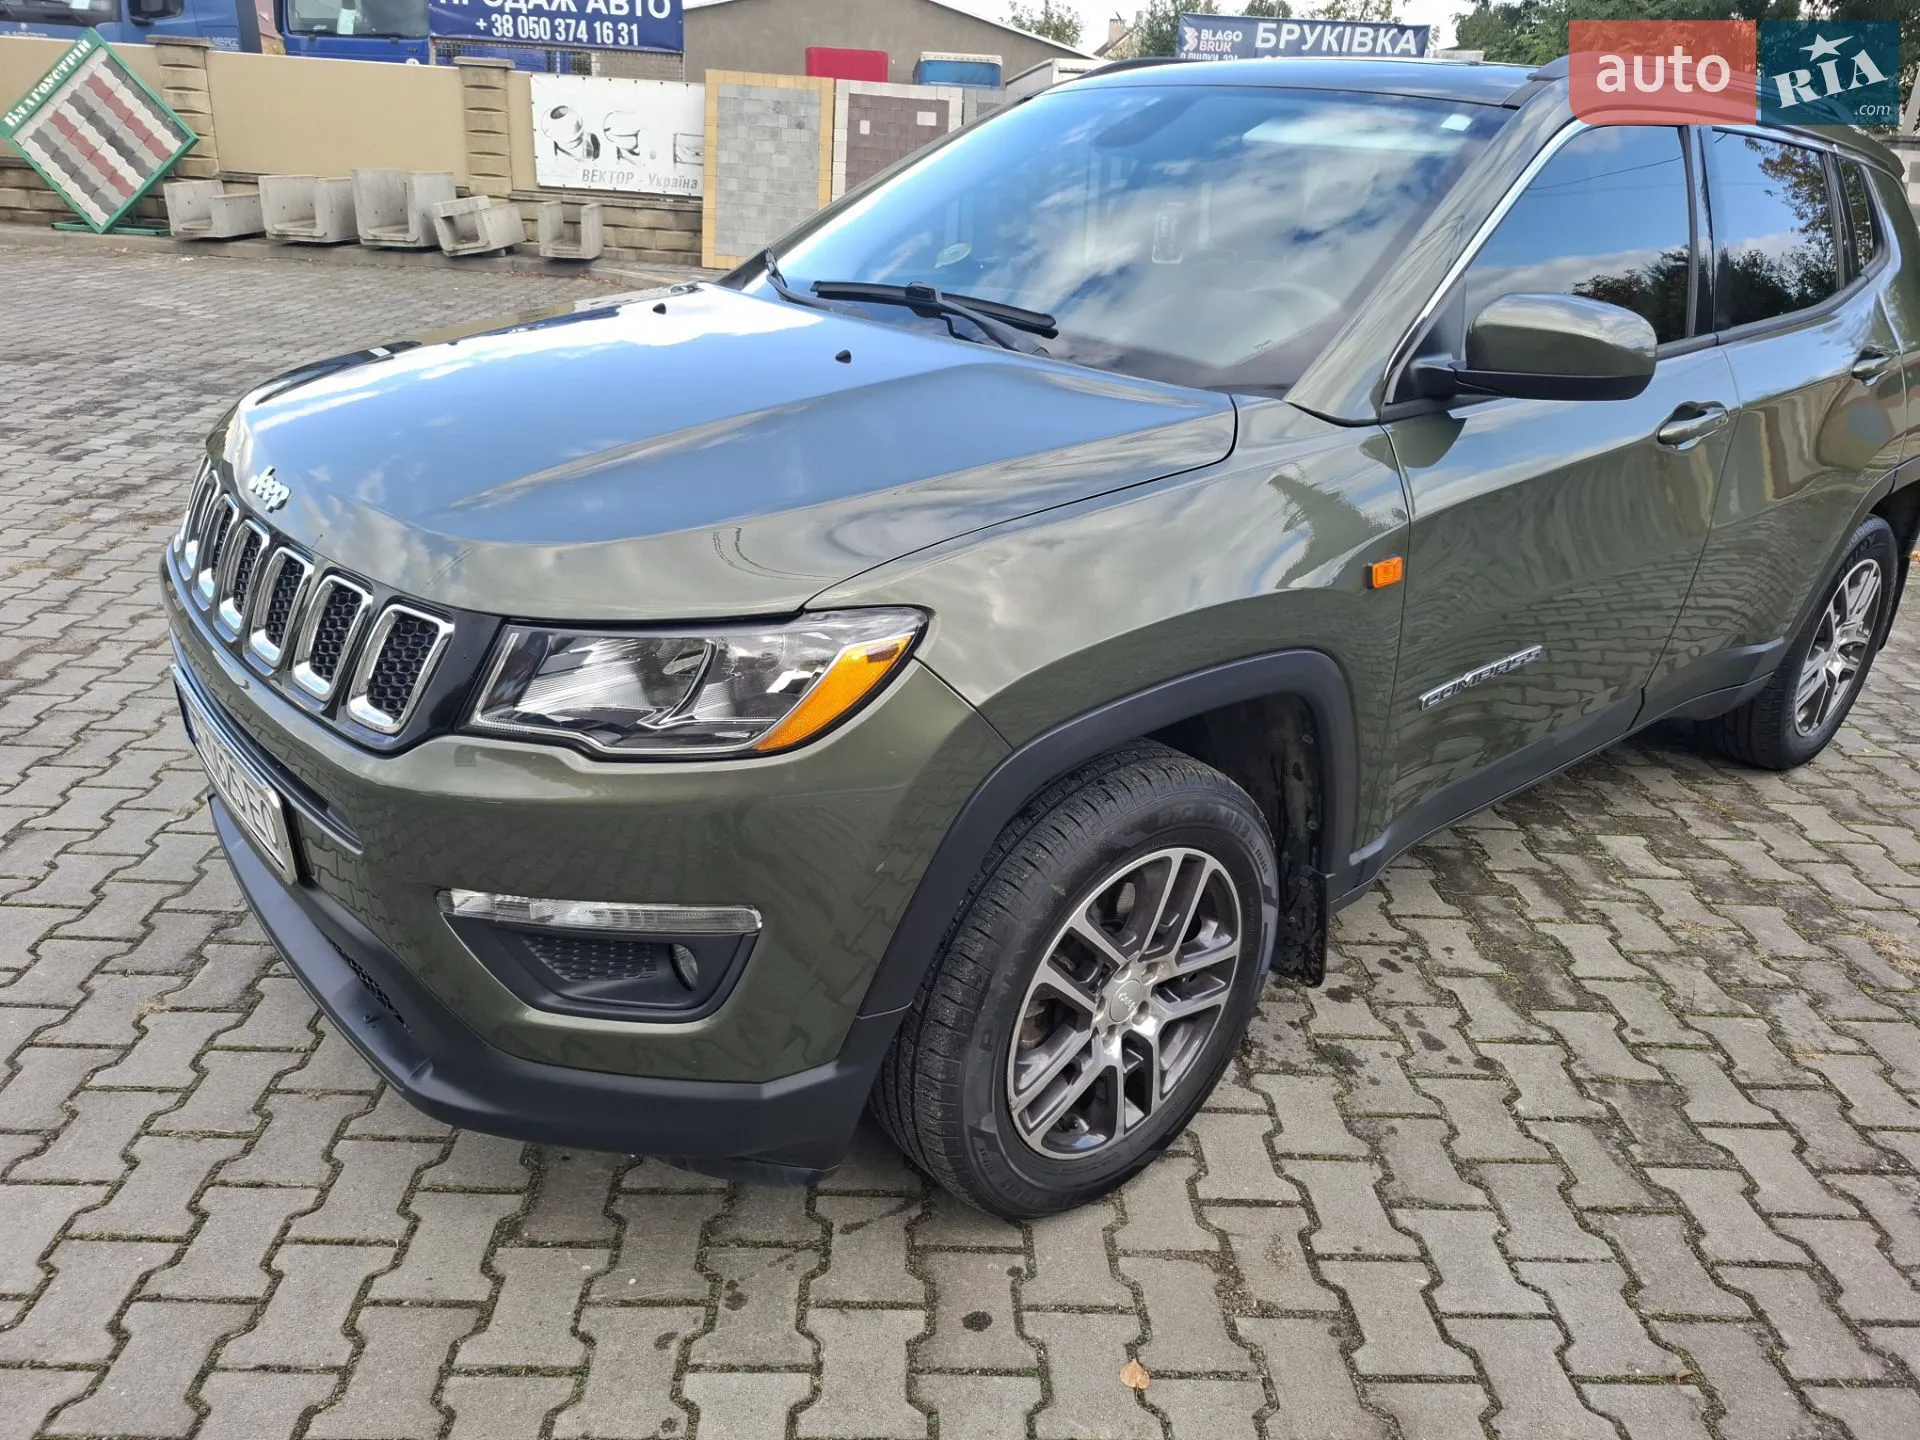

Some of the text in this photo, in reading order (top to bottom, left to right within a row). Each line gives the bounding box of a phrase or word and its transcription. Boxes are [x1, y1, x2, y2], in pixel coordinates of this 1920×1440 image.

[491, 13, 514, 38] 38
[517, 15, 552, 40] 050
[554, 18, 589, 43] 374
[593, 20, 614, 45] 16
[617, 22, 639, 46] 31
[1201, 28, 1243, 42] BLAGO
[1255, 22, 1418, 55] БРУКІВКА
[1199, 40, 1232, 52] BRUK
[582, 168, 634, 185] ВЕКТОР
[648, 173, 699, 189] Україна
[1420, 645, 1542, 711] COMPASS
